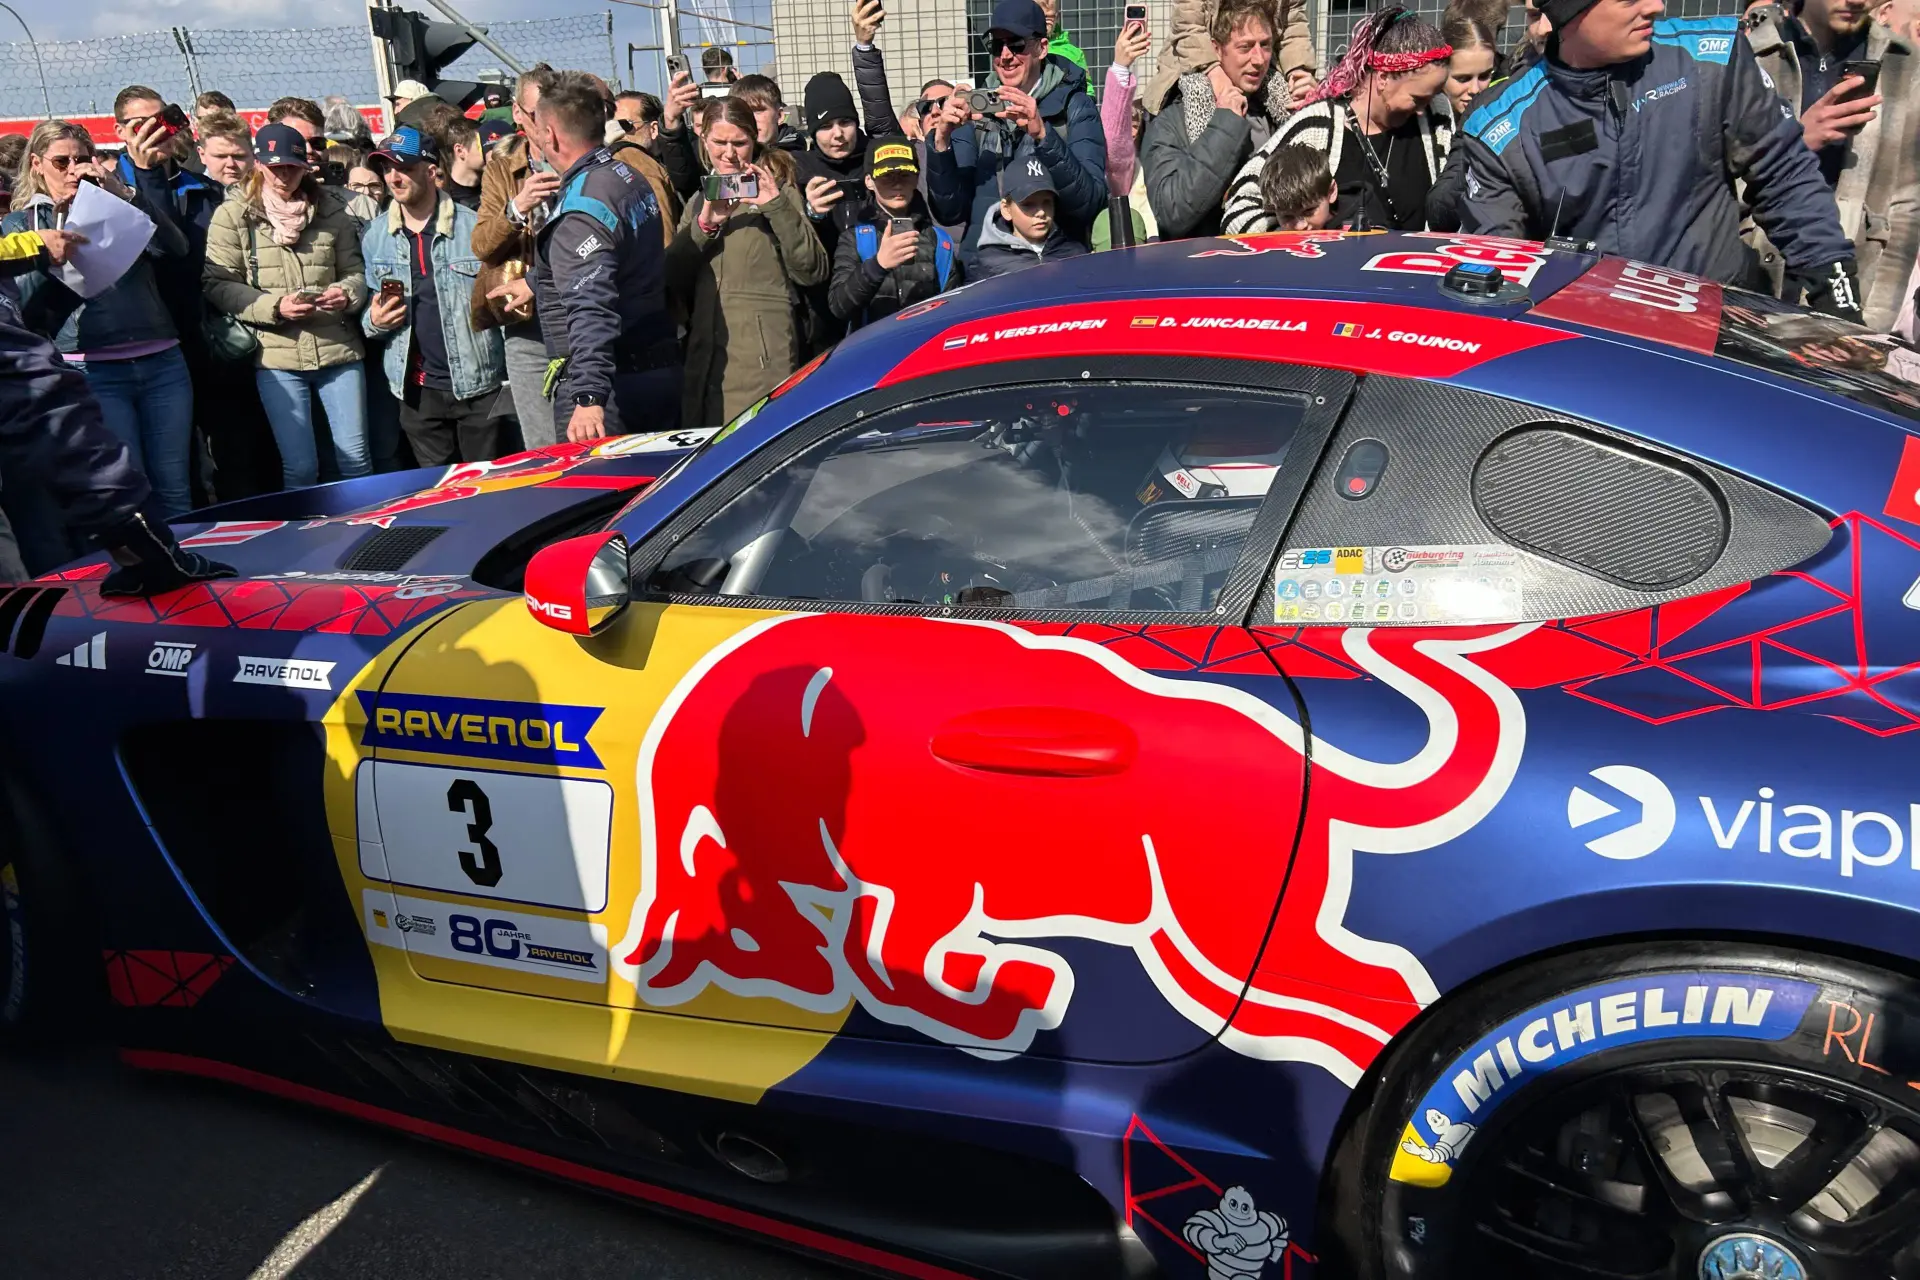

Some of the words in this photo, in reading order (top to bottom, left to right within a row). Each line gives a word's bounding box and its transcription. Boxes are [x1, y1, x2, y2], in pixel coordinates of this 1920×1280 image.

[1699, 40, 1729, 51] OMP
[1660, 83, 1687, 98] RACING
[1488, 120, 1512, 143] OMP
[577, 236, 601, 258] OMP
[970, 332, 989, 345] M.
[994, 318, 1108, 340] VERSTAPPEN
[1159, 316, 1177, 328] D.
[1181, 317, 1308, 332] JUNCADELLA
[1365, 328, 1383, 340] J.
[1387, 330, 1482, 354] GOUNON
[1176, 473, 1191, 490] BELL
[1336, 549, 1363, 559] ADAC
[526, 595, 572, 620] AMG
[148, 646, 193, 671] OMP
[243, 663, 323, 682] RAVENOL
[376, 707, 580, 752] RAVENOL
[446, 778, 504, 888] 3
[1698, 786, 1920, 878] viapl
[448, 913, 521, 960] 80
[497, 929, 532, 941] JAHRE
[530, 947, 591, 965] RAVENOL
[1822, 999, 1893, 1077] RL
[1452, 986, 1775, 1115] MICHELIN
